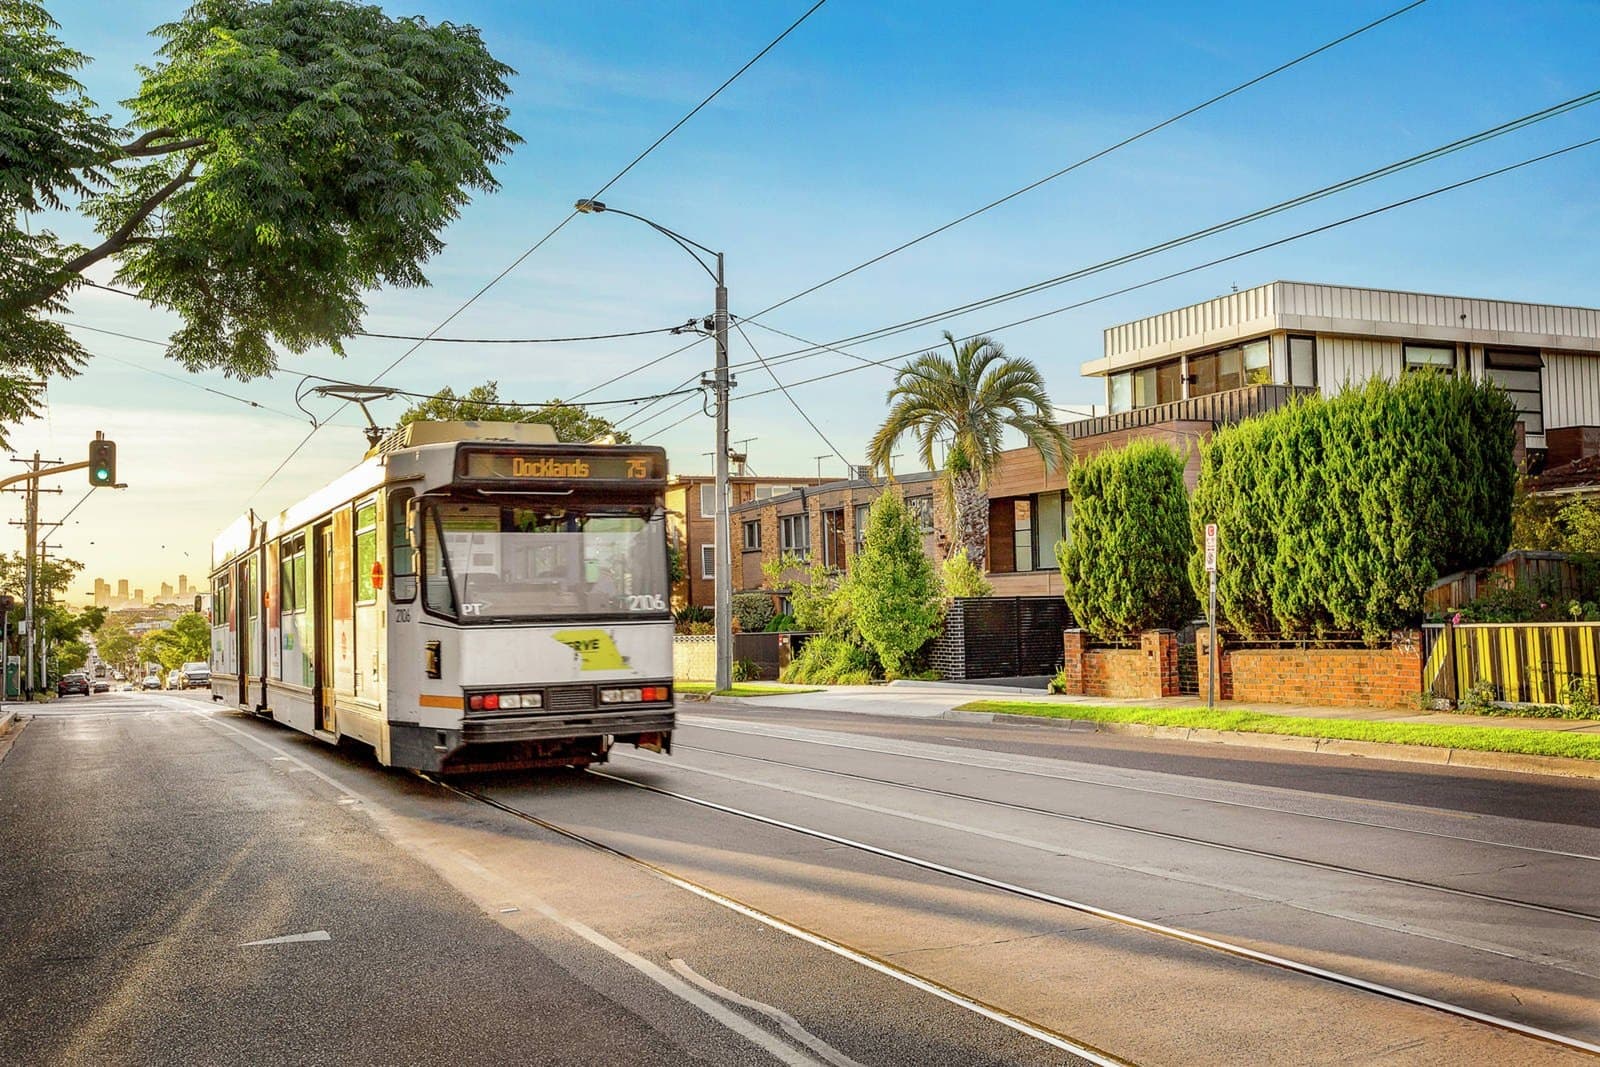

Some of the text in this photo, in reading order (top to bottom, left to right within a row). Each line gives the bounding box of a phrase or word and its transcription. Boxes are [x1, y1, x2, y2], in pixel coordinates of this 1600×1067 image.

[512, 457, 647, 479] Docklands 75
[629, 594, 666, 611] 2106
